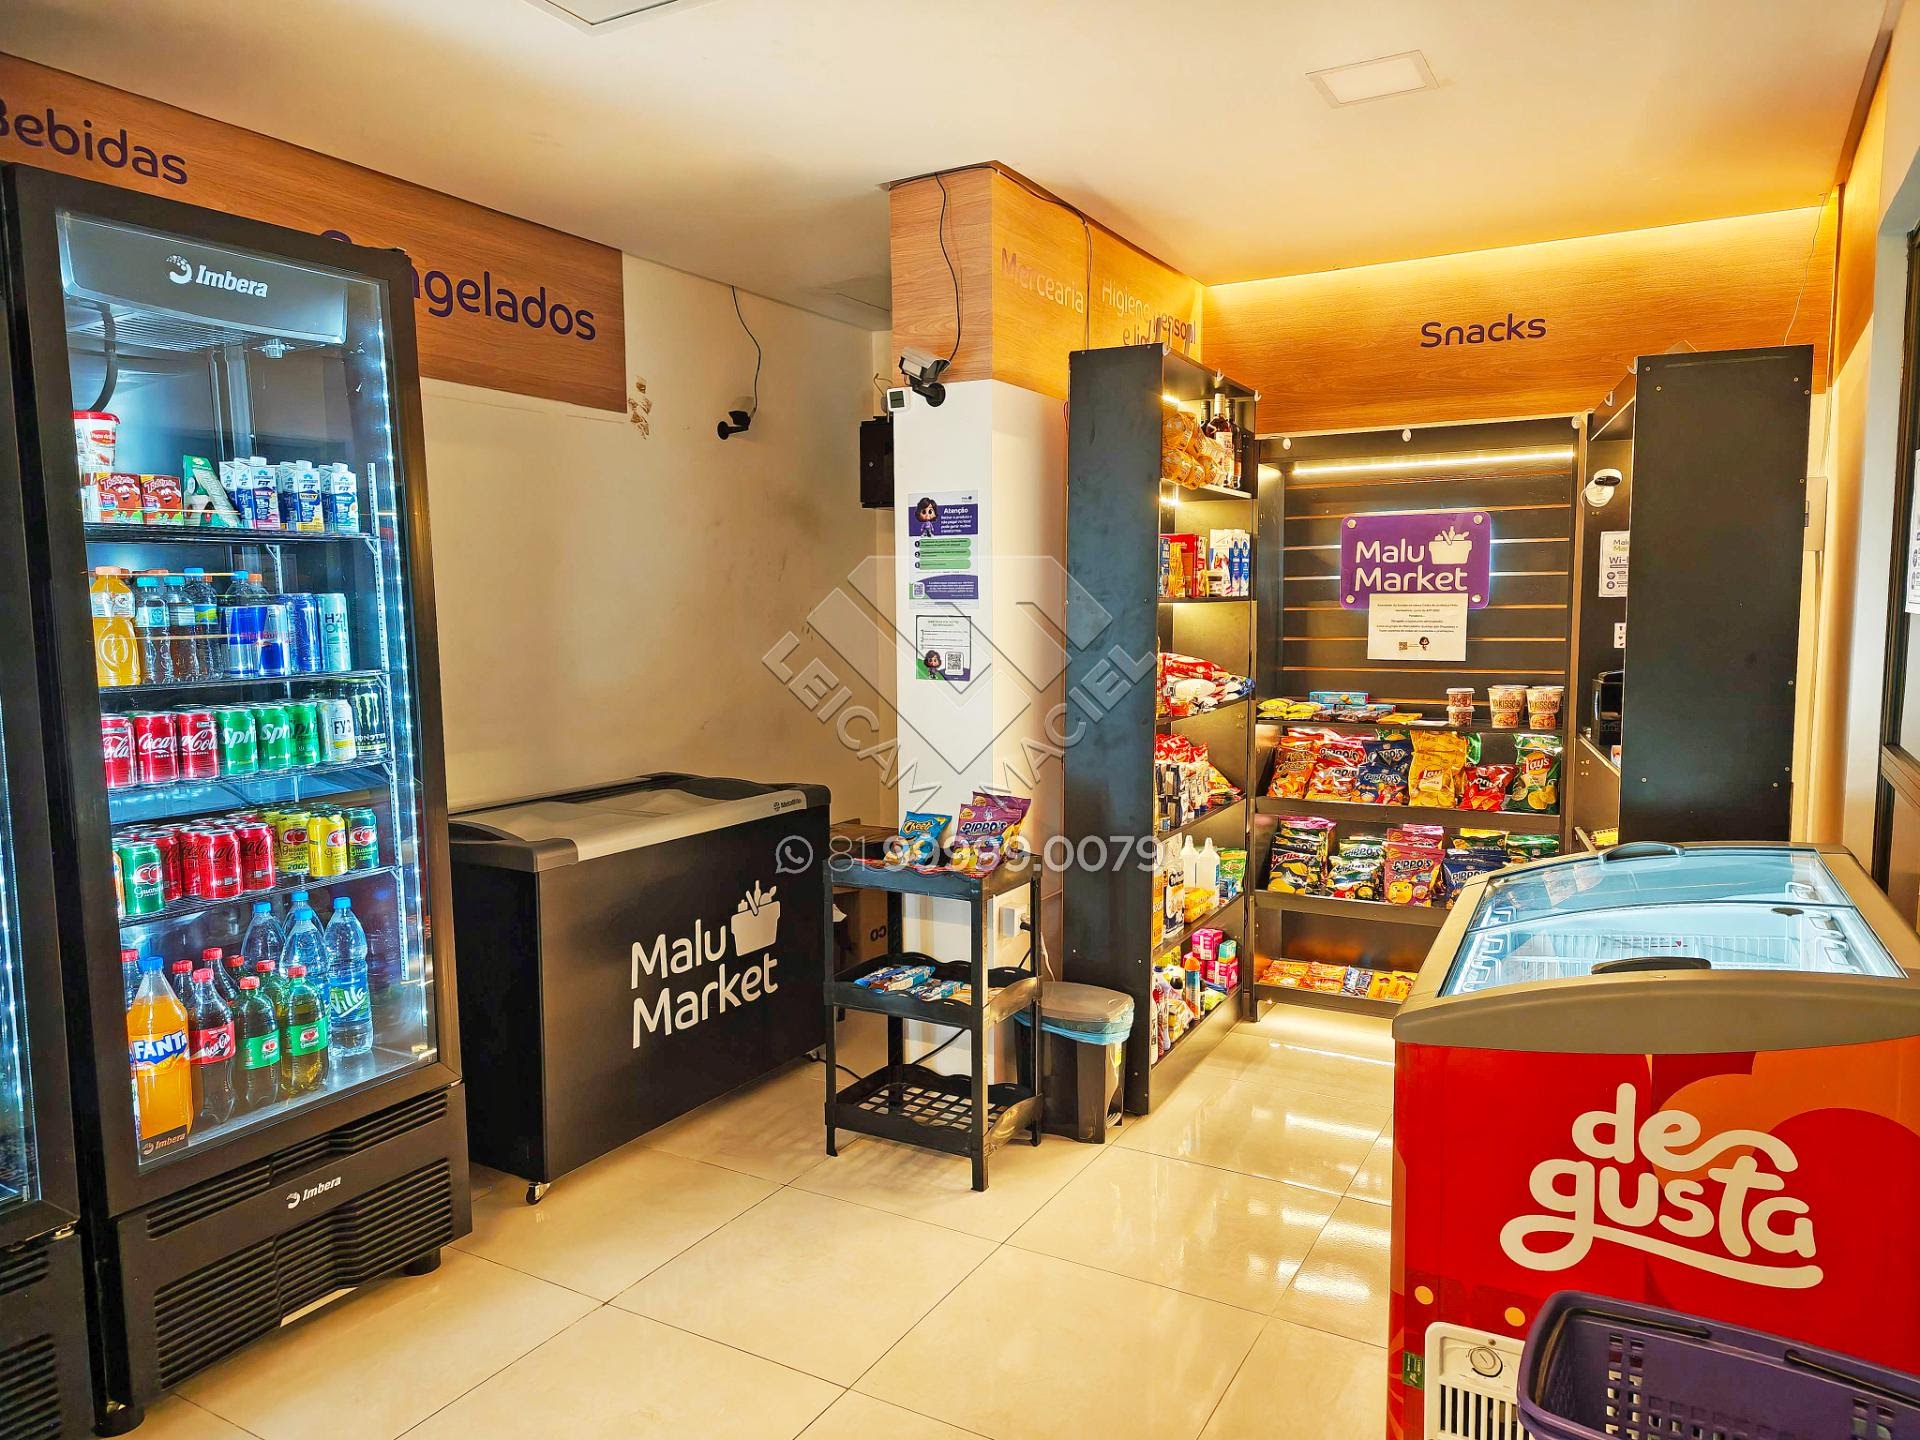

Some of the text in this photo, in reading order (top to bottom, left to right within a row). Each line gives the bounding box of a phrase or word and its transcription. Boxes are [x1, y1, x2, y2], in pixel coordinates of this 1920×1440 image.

[195, 263, 269, 298] Imbera
[1001, 248, 1084, 314] Mercearia
[1102, 279, 1150, 319] Higiene
[1420, 313, 1547, 348] Snacks
[943, 506, 969, 515] Atenção
[1355, 538, 1426, 564] Malu
[1354, 565, 1468, 592] Market
[962, 822, 1008, 835] PIPPO'S
[1392, 859, 1433, 872] PIPPO'S
[631, 918, 728, 990] Malu
[632, 953, 779, 1050] Market
[155, 1133, 187, 1149] Imbera
[1572, 1082, 1799, 1173] de
[302, 1176, 342, 1202] Imbera
[1499, 1155, 1824, 1289] gusta
